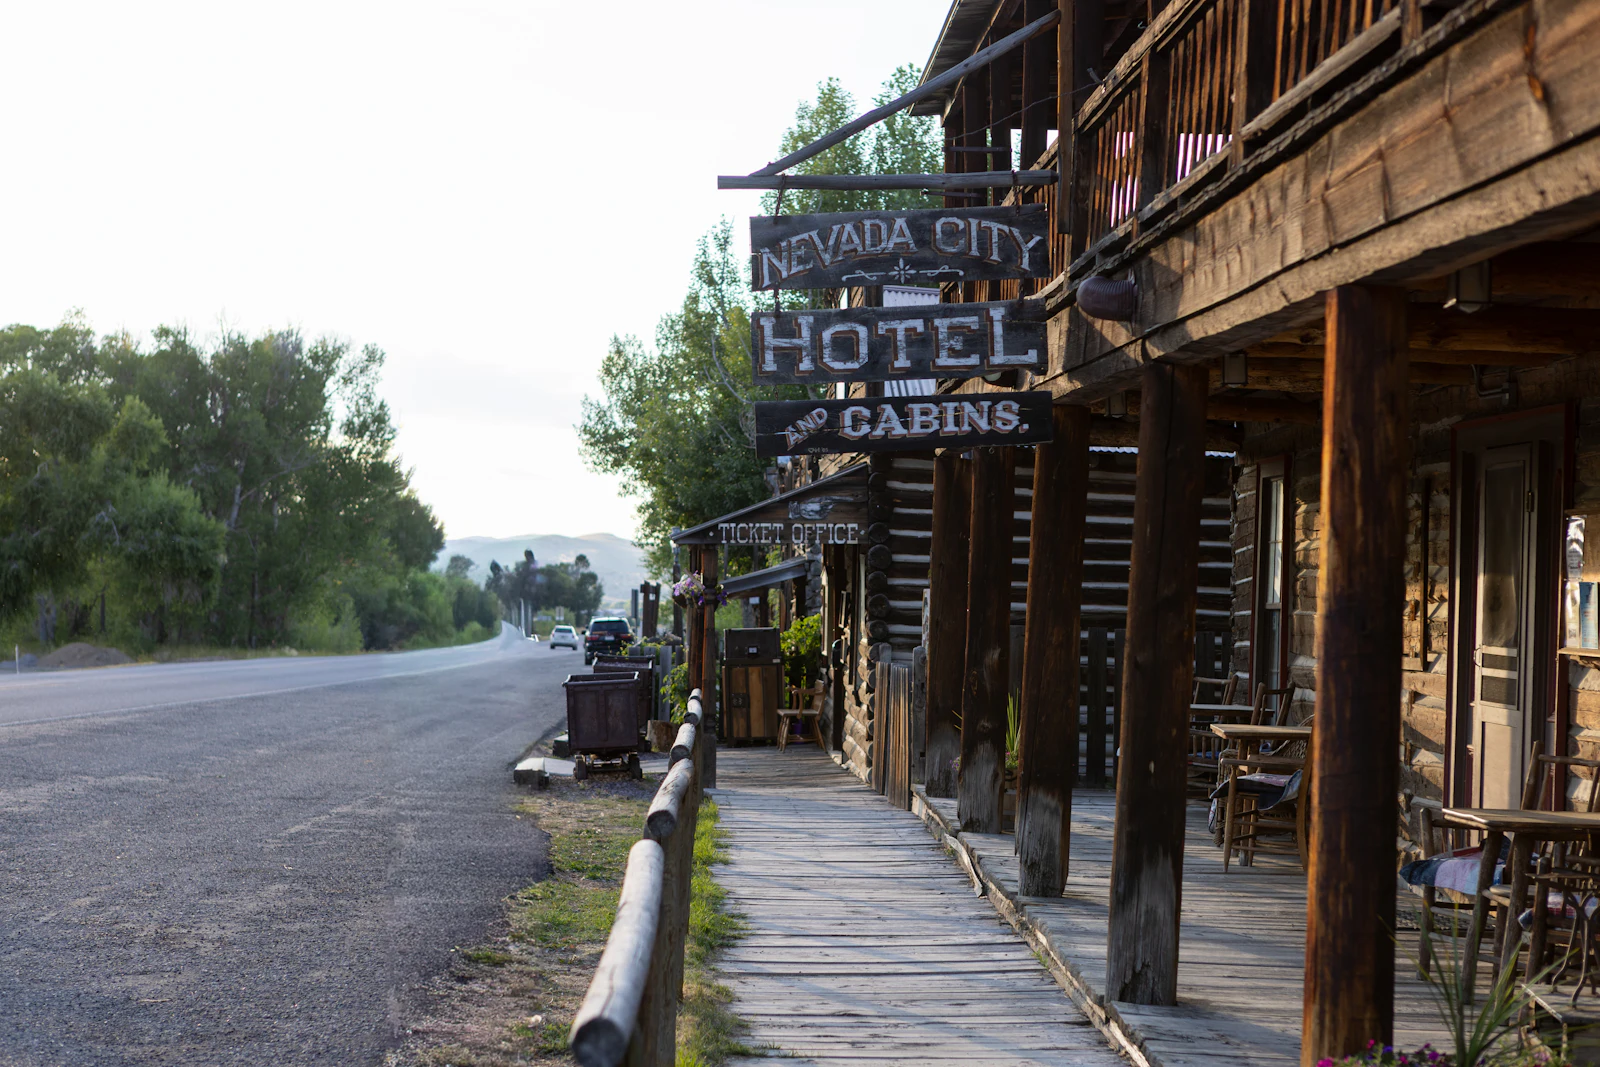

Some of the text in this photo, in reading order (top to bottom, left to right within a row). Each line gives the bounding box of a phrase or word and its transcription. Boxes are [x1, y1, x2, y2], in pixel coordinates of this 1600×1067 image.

[758, 216, 1043, 288] NEVADA CITY
[757, 307, 1038, 376] HOTEL
[785, 401, 1030, 450] AND CABINS.
[718, 522, 859, 544] TICKET OFFICE
